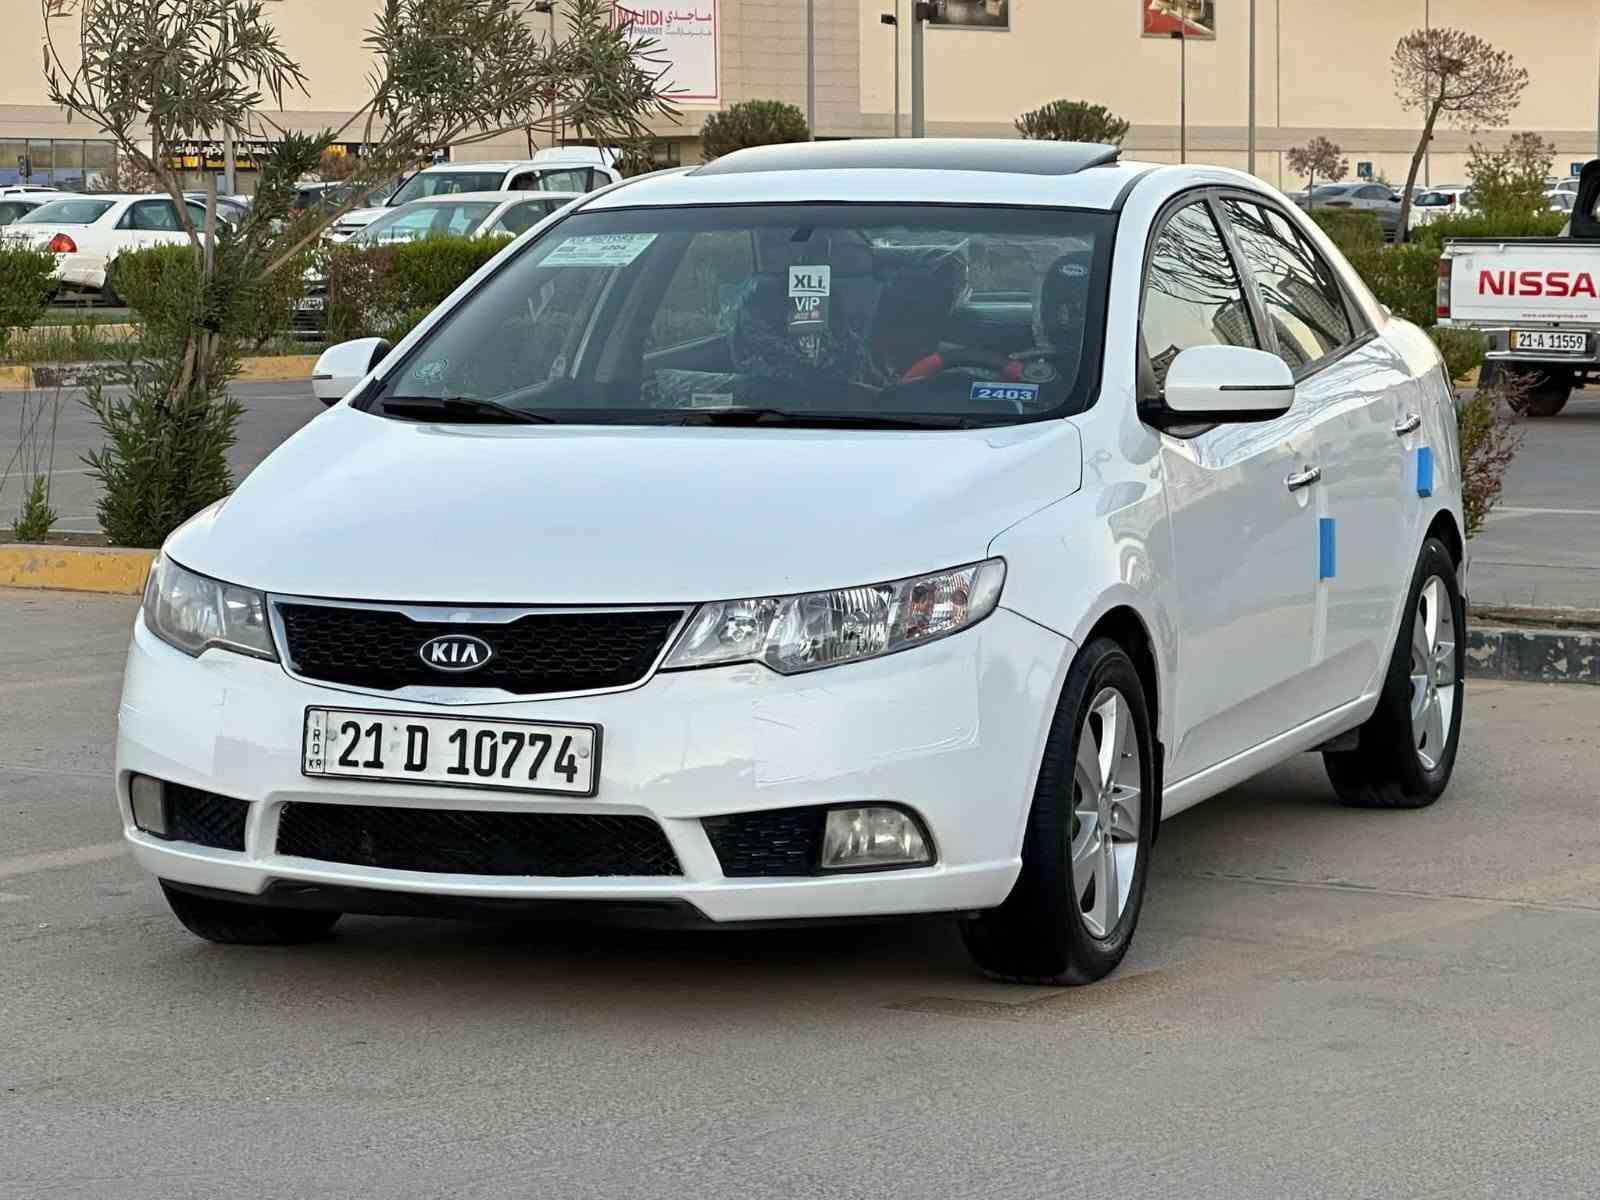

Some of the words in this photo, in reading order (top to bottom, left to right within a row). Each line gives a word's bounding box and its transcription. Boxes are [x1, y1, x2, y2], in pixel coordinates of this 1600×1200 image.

[617, 9, 663, 25] MAJIDI
[1478, 270, 1600, 298] NISSA
[1549, 334, 1584, 349] 11559
[977, 388, 1034, 400] 2403
[430, 641, 479, 664] KIA
[338, 720, 385, 770] 21
[403, 723, 430, 772] D
[446, 727, 579, 783] 10774
